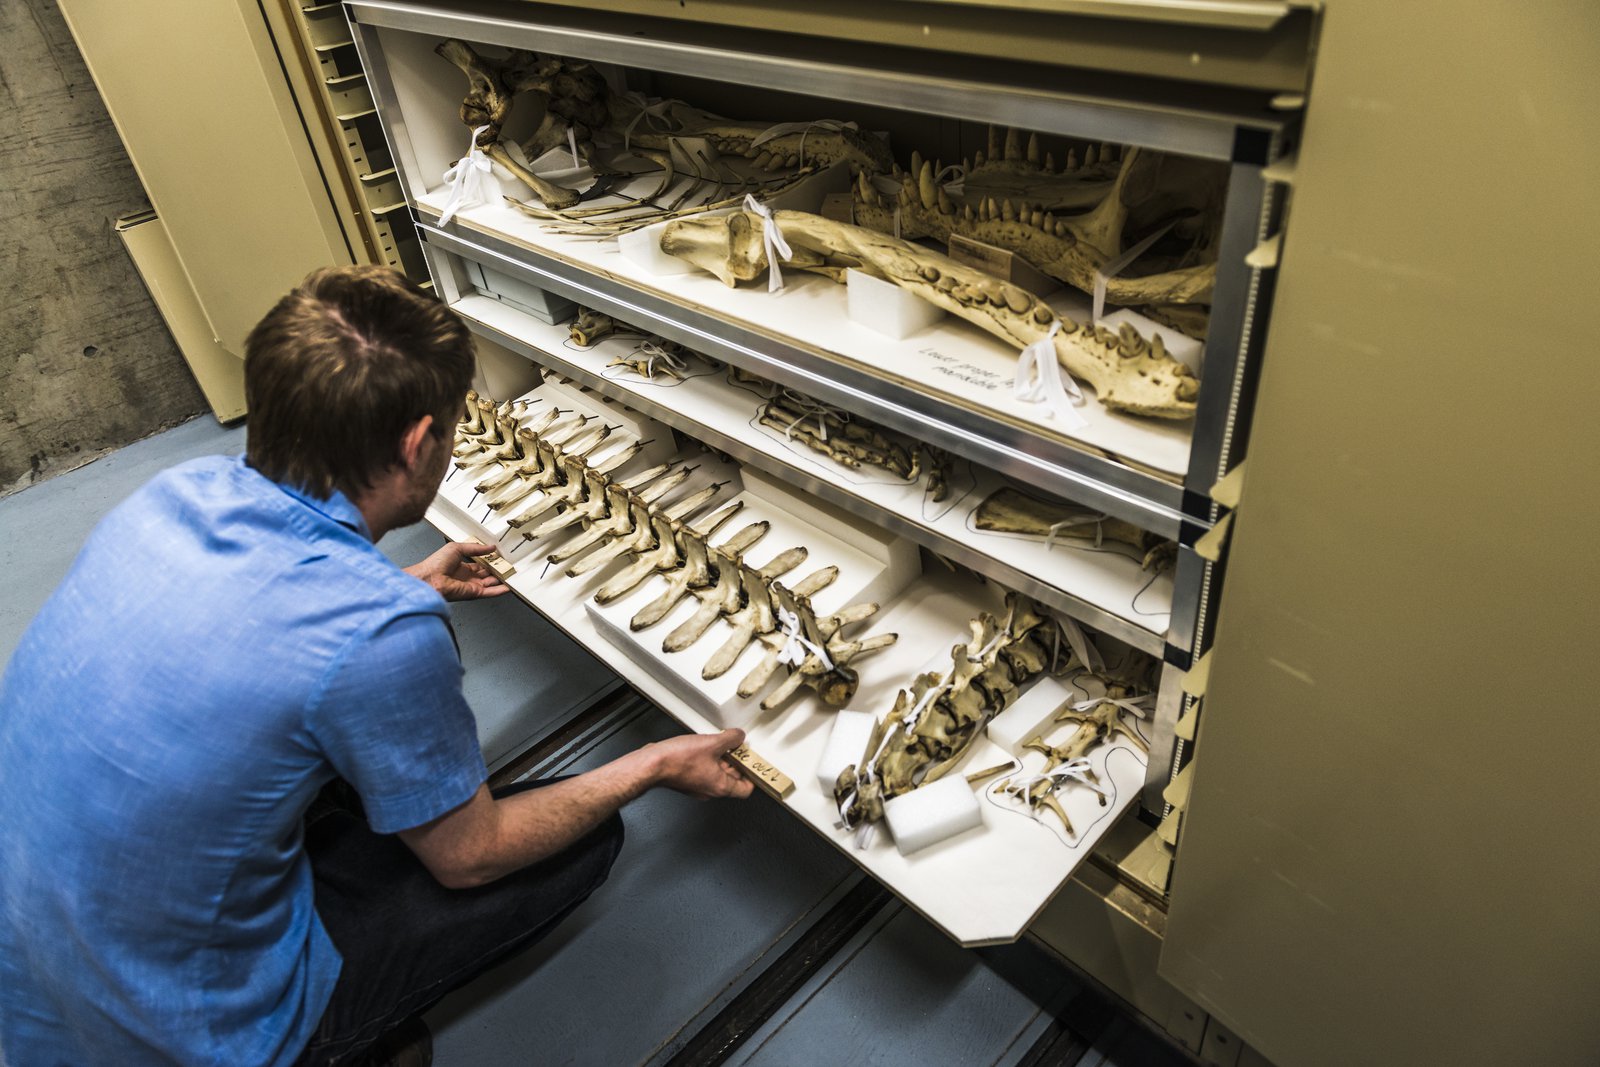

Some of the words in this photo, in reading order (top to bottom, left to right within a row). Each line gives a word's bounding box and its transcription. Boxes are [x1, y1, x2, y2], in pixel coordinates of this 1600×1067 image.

[918, 347, 960, 363] Lower
[734, 748, 751, 761] de
[752, 762, 774, 776] out
